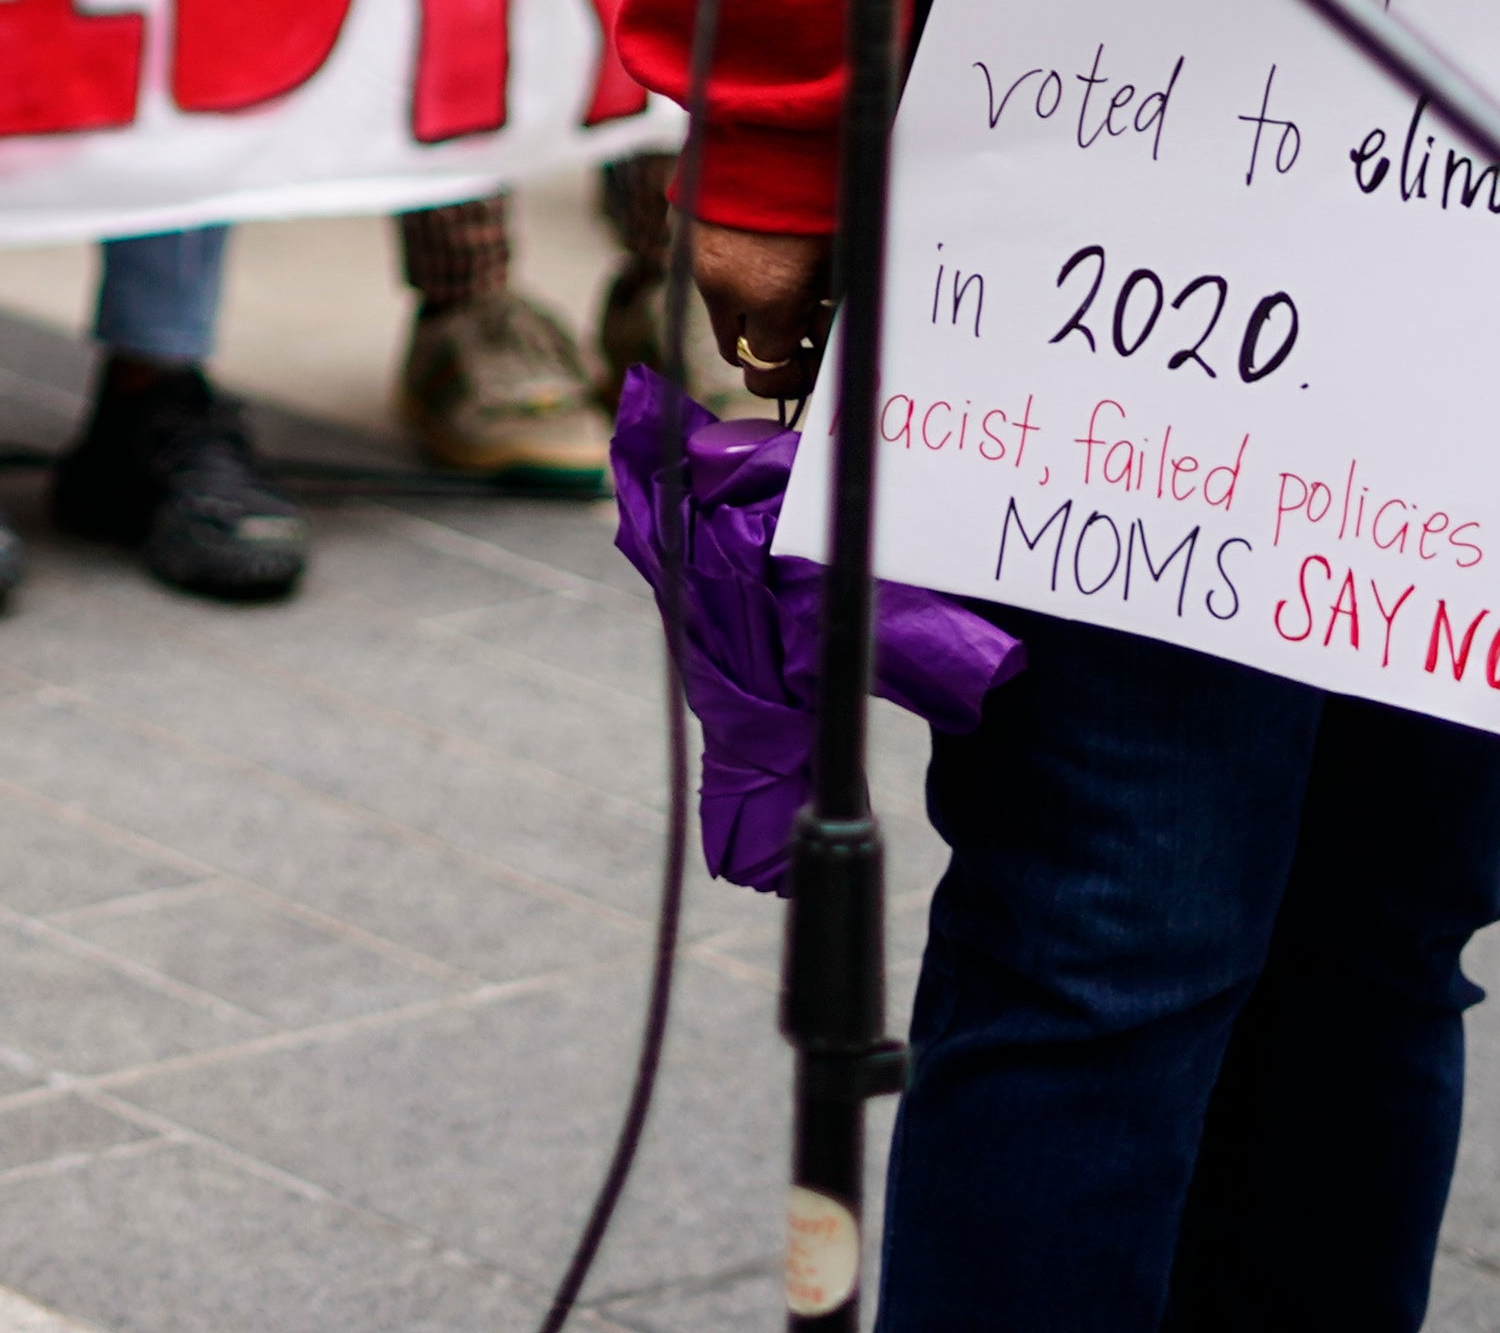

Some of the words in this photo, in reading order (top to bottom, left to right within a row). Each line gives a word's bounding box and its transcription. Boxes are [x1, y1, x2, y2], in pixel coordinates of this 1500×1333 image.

[972, 43, 1185, 161] voted
[1237, 64, 1301, 185] to
[929, 240, 988, 338] in
[1049, 244, 1310, 390] 2020.
[829, 393, 1052, 487] acist,
[1074, 400, 1250, 511] failed
[1274, 459, 1484, 569] policies
[994, 495, 1252, 621] MOMS
[1274, 554, 1415, 669] SAY
